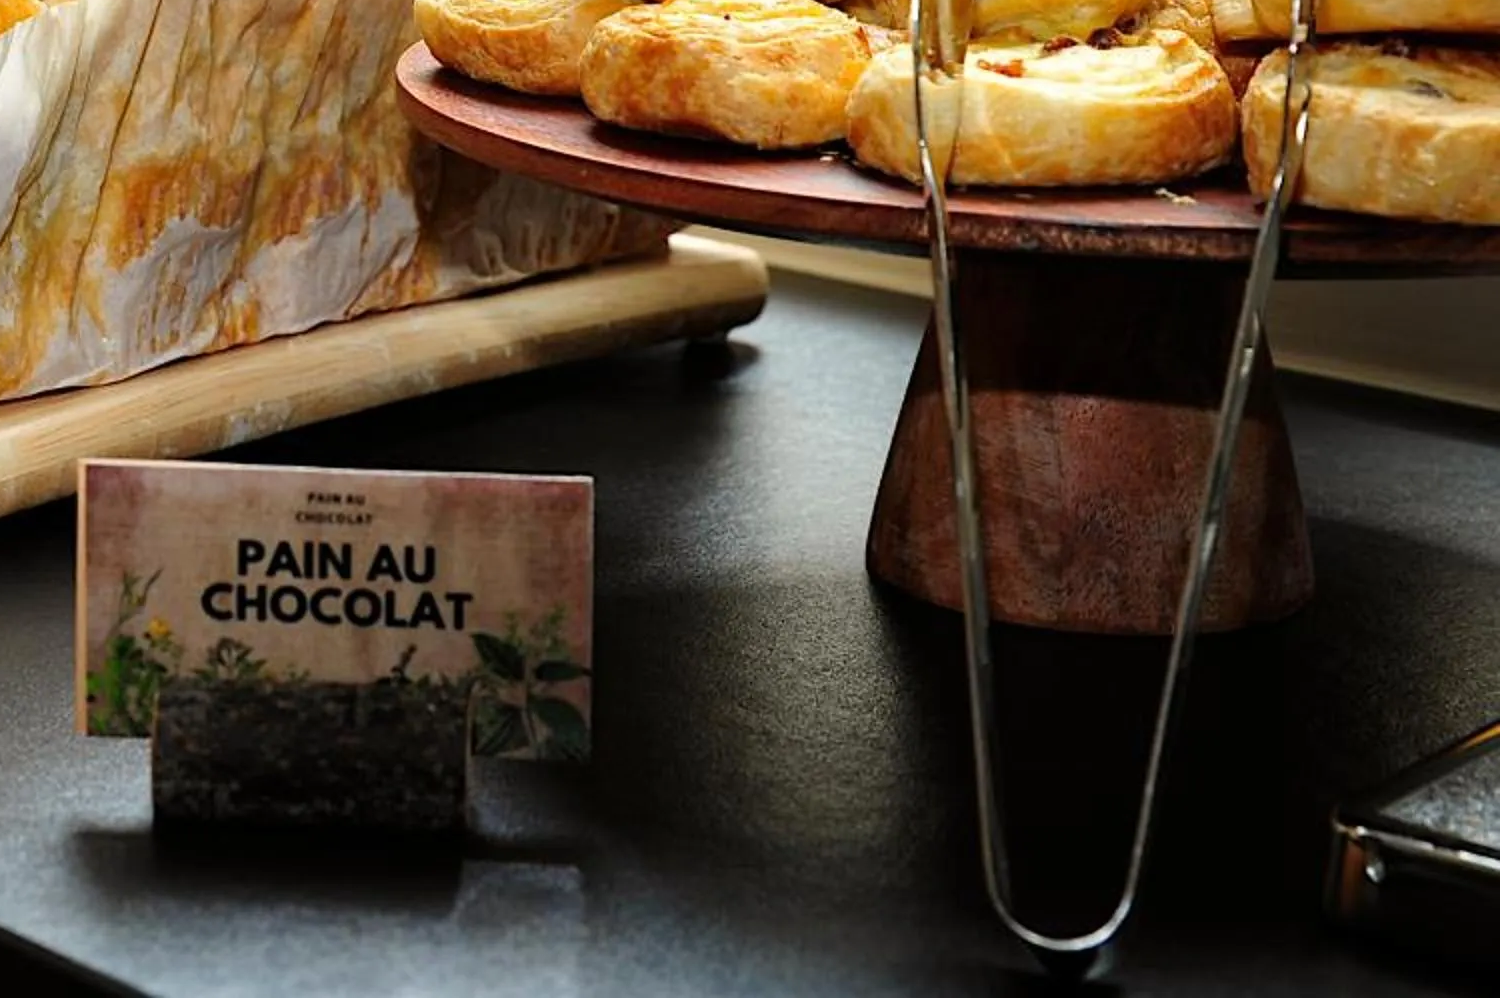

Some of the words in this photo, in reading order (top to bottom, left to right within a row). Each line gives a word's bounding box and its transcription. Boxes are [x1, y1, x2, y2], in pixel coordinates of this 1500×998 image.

[307, 491, 341, 504] PAIN
[346, 493, 366, 506] AU
[295, 510, 373, 525] CHOCOLAT
[237, 539, 352, 580] PAIN
[366, 544, 436, 584] AU
[201, 583, 474, 631] CHOCOLAT
